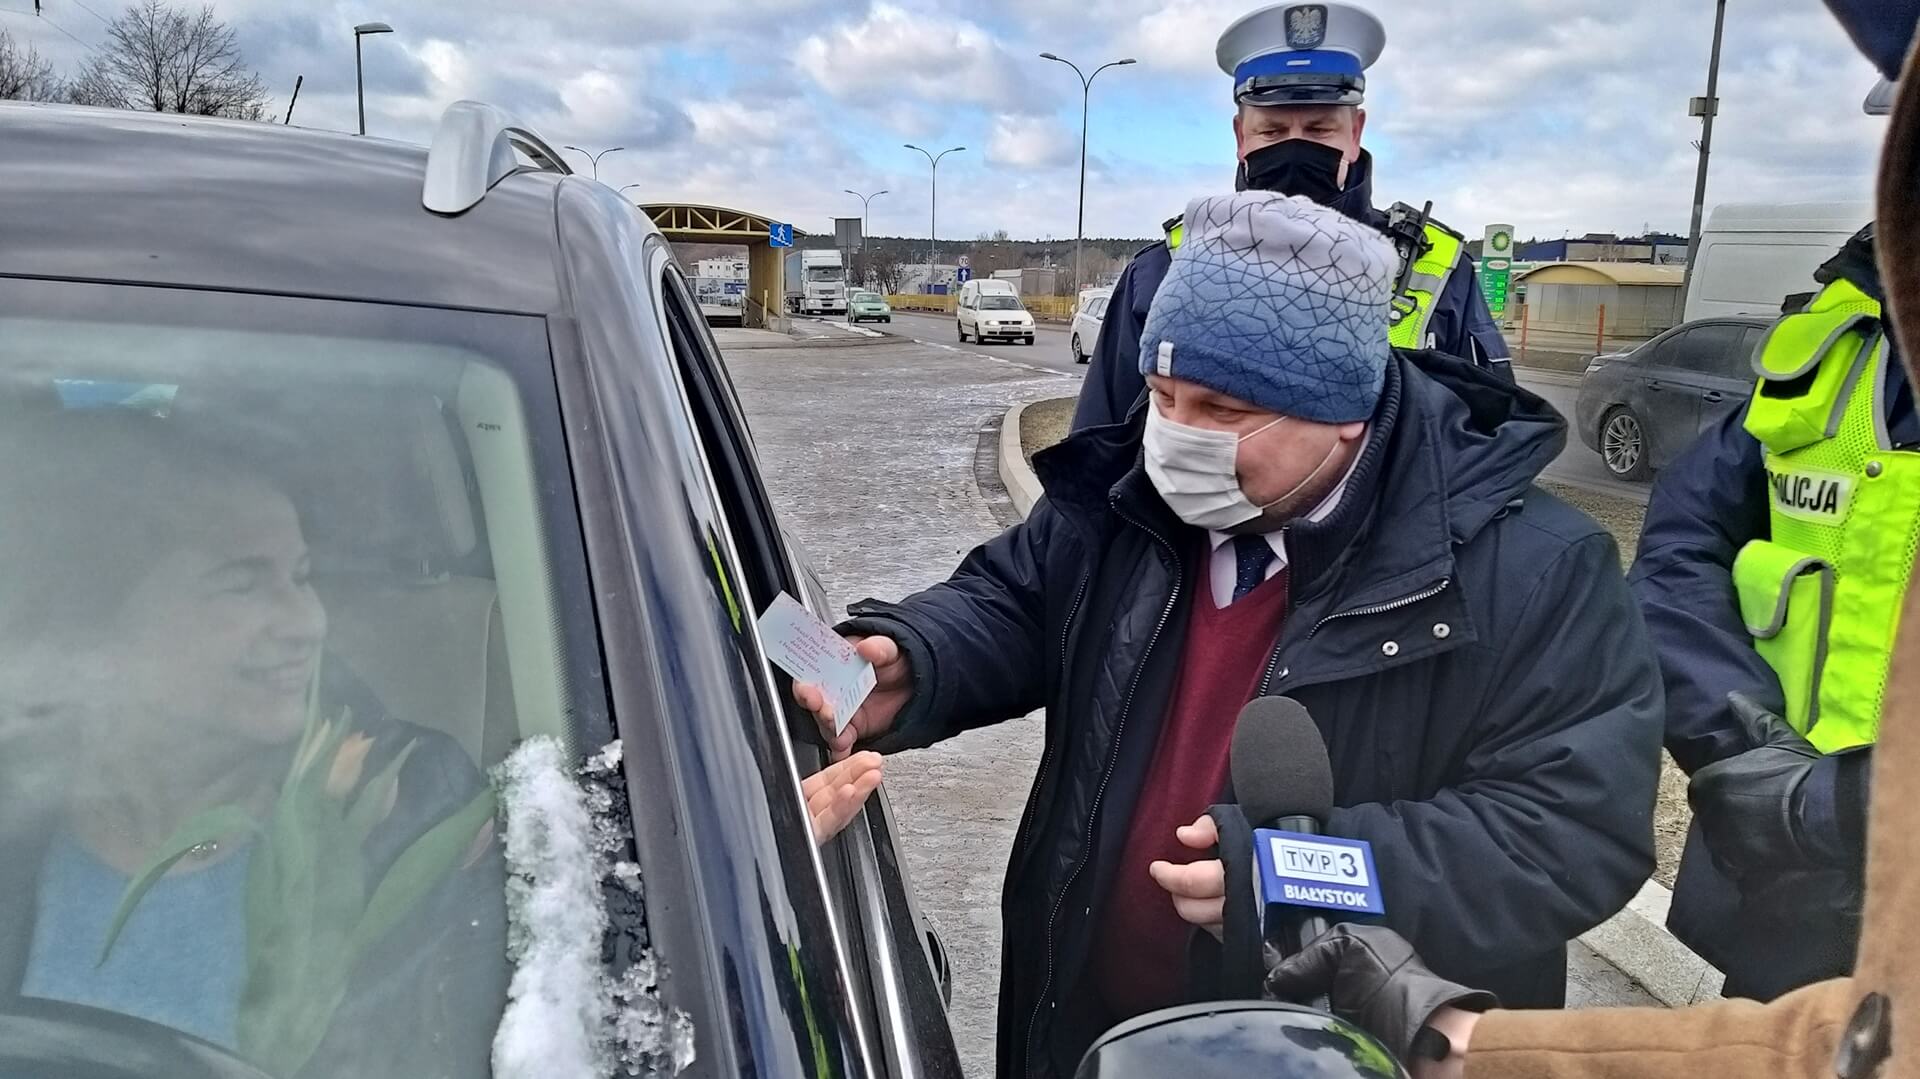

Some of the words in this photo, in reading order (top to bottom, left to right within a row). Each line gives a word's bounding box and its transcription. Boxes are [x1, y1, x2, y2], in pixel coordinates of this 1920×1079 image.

[1286, 850, 1331, 871] TVP
[1340, 852, 1358, 878] 3
[1284, 884, 1368, 907] BIAŁYSTOK
